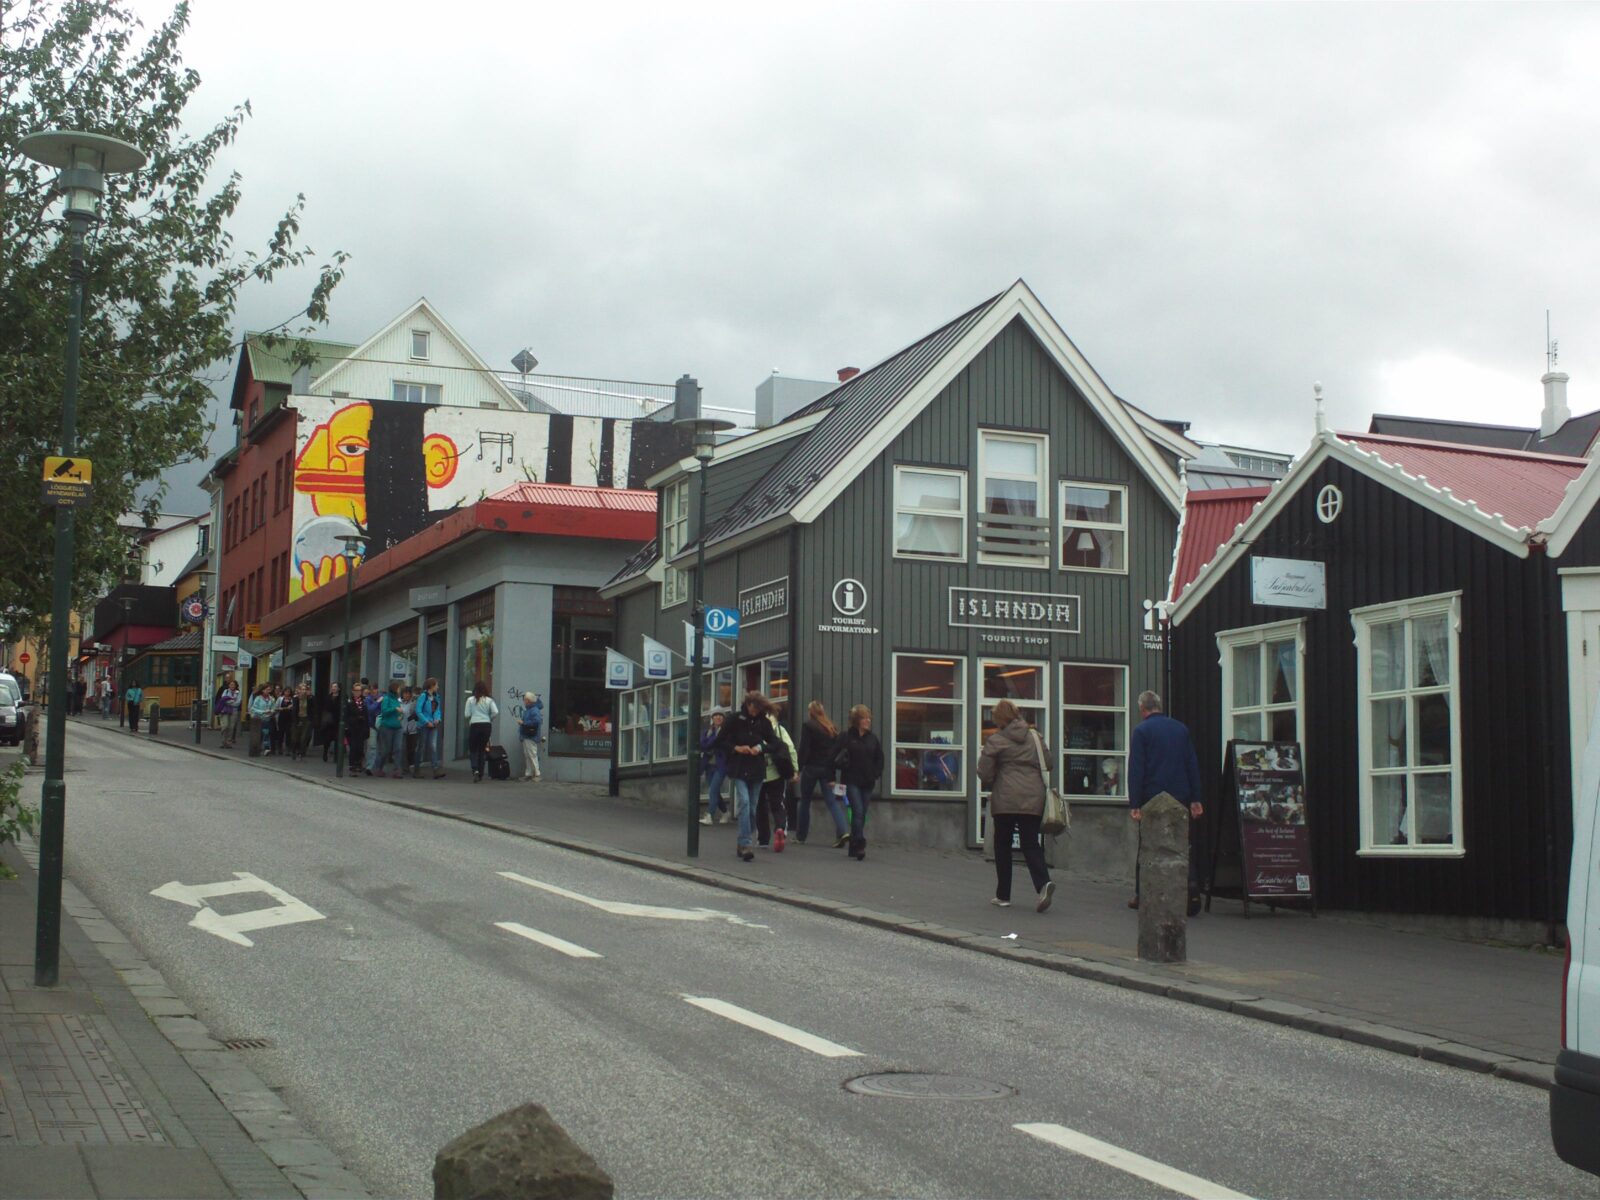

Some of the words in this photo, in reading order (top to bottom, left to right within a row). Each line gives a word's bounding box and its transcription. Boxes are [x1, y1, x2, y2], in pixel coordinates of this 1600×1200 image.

[741, 588, 785, 617] ISLANDIA
[959, 598, 1070, 622] ISLANDIA
[832, 617, 866, 625] TOURIST
[818, 624, 872, 634] INFORMATION
[982, 634, 1022, 643] TOURIST
[1024, 637, 1049, 645] SHOP
[583, 739, 612, 747] aurum
